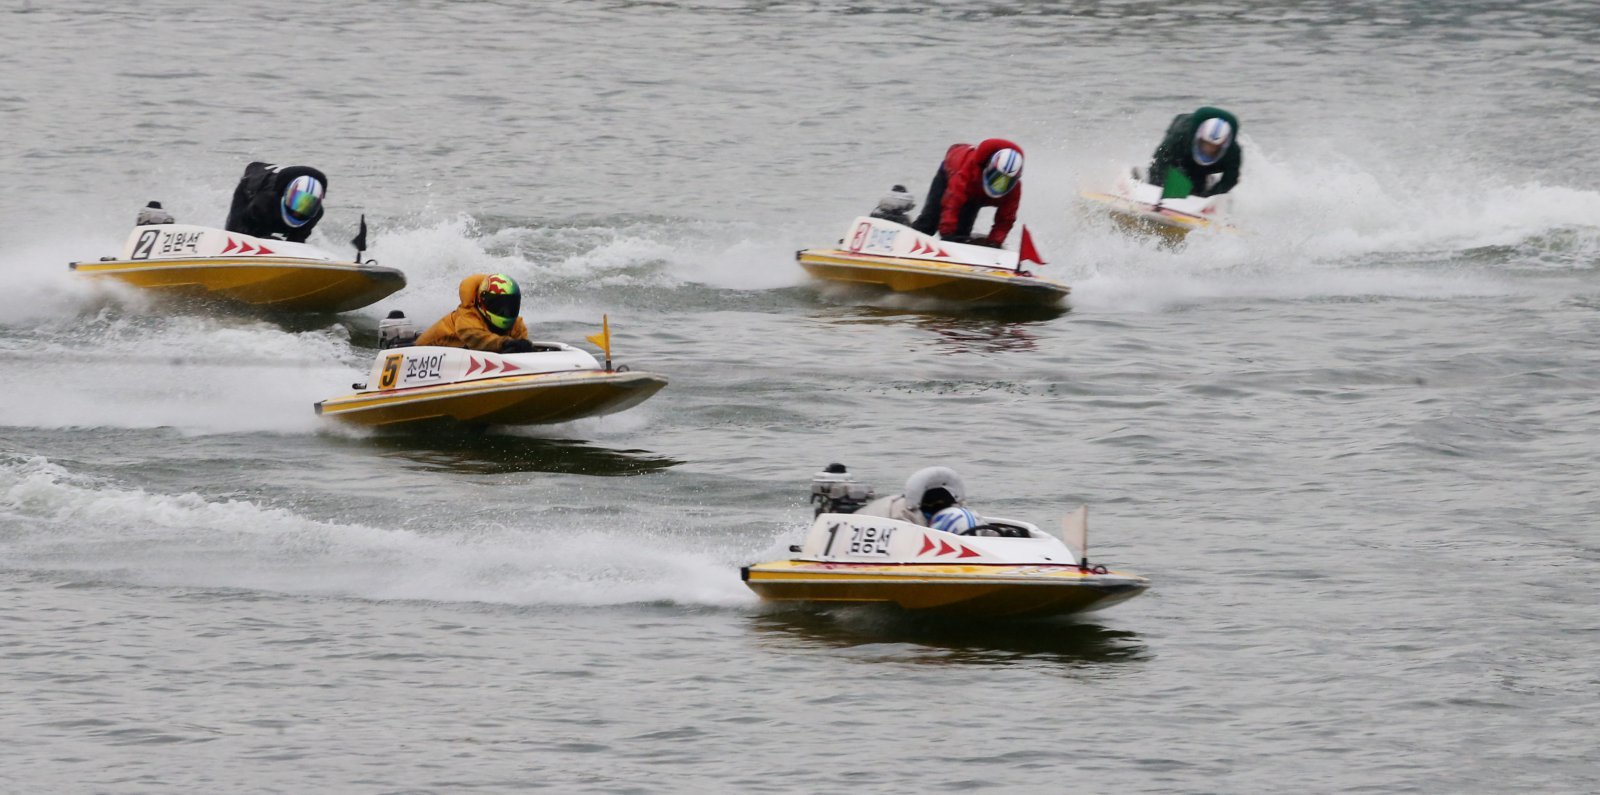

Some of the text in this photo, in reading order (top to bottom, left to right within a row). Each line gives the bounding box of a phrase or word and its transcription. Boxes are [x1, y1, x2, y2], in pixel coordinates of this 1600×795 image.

[135, 231, 201, 259] 2 김완석
[382, 355, 443, 387] 5 조성인
[823, 523, 892, 557] 1 김응선
